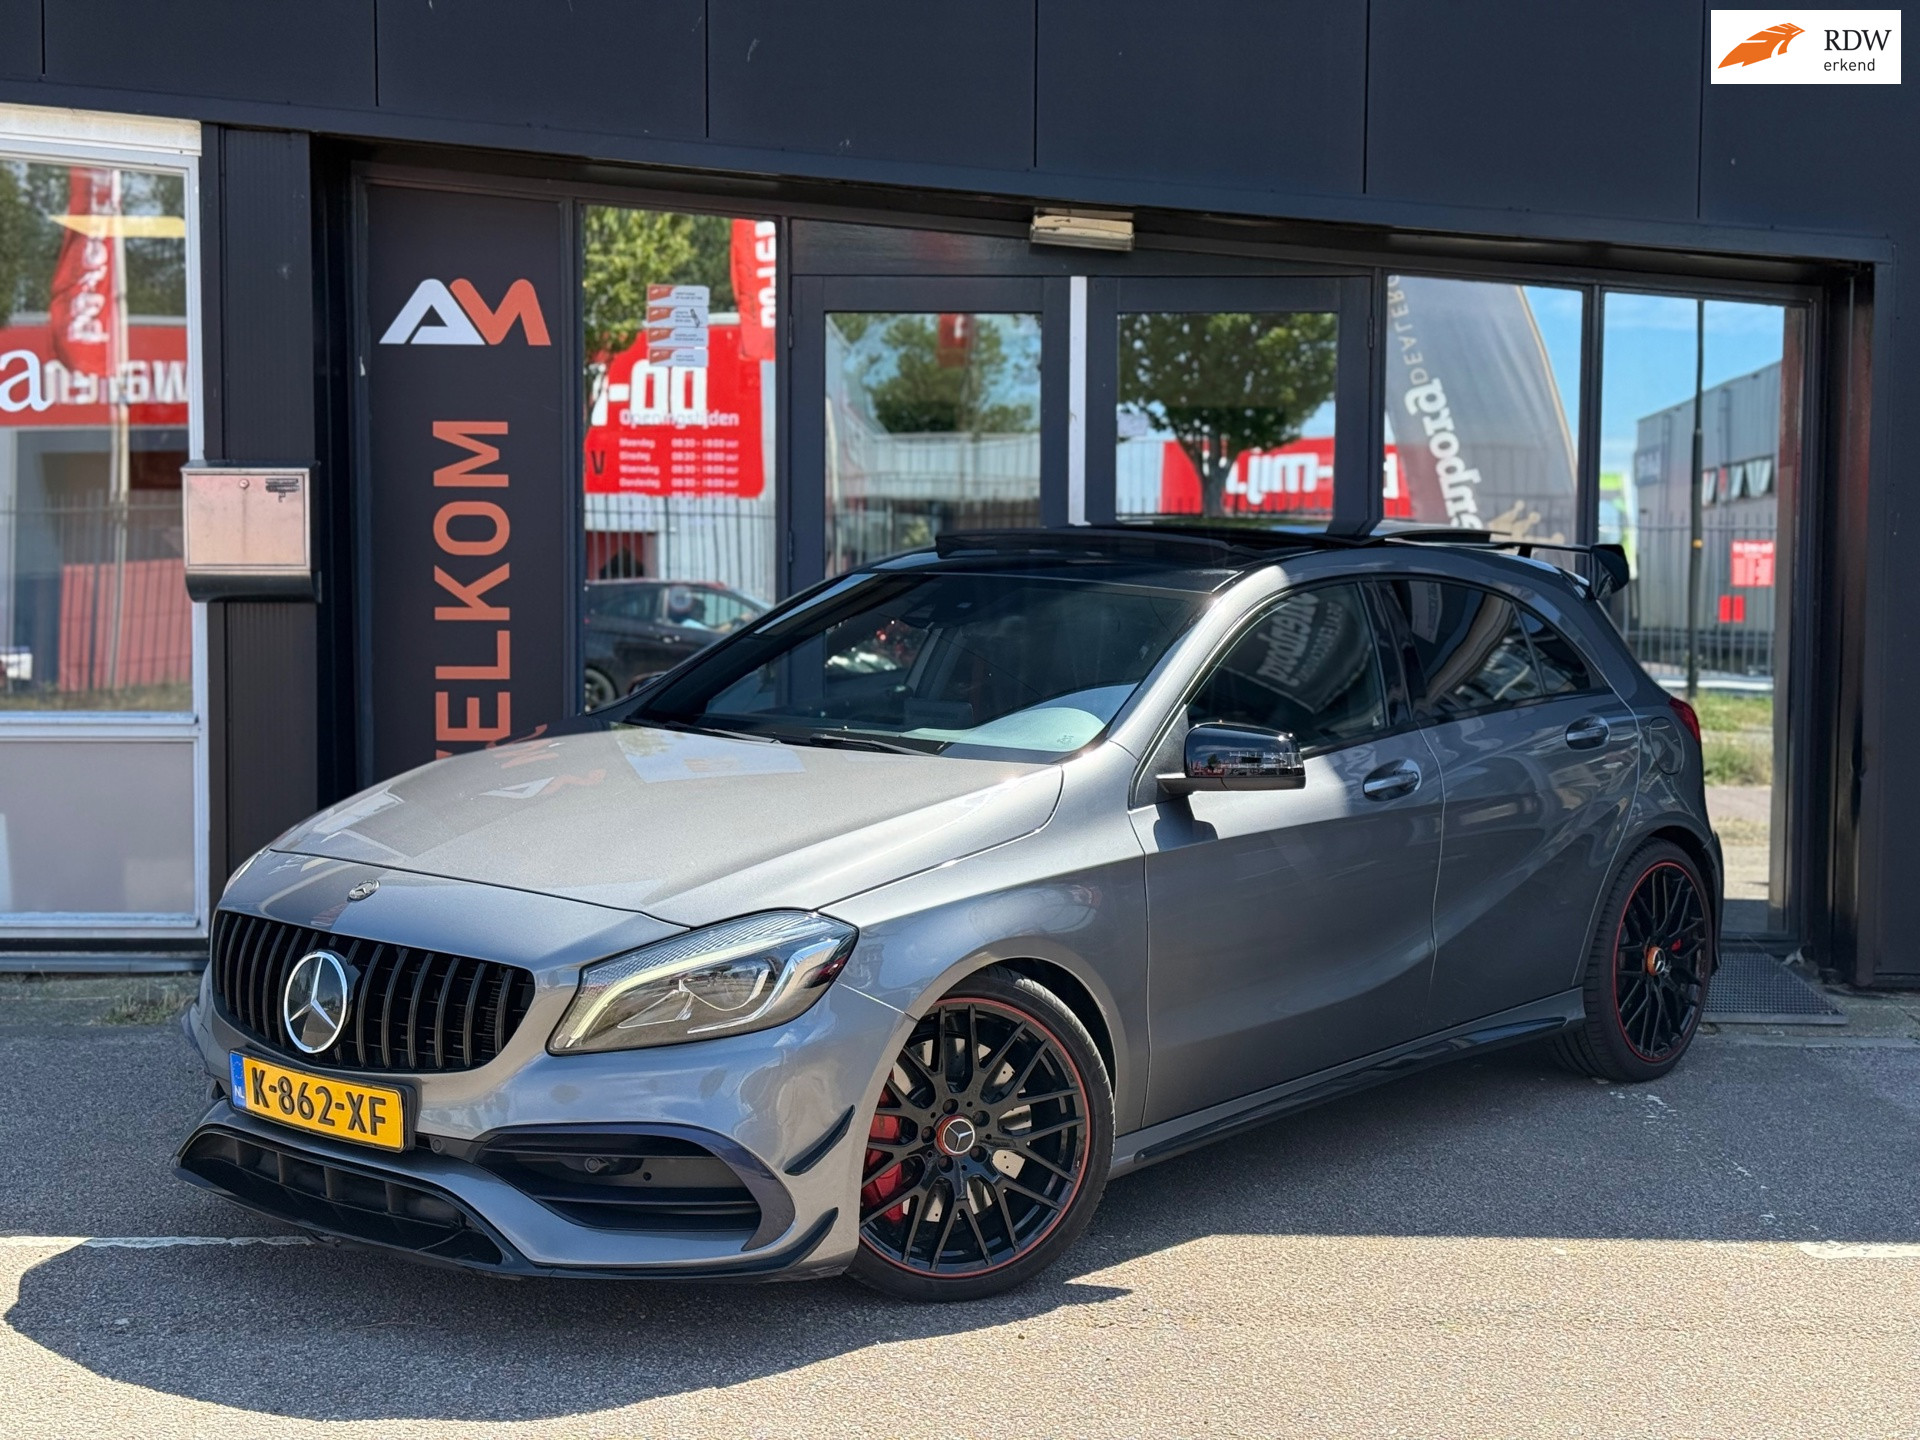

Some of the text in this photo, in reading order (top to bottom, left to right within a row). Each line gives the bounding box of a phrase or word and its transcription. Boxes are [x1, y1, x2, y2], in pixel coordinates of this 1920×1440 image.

[432, 421, 511, 759] ELKOM
[234, 1084, 245, 1099] NL
[251, 1066, 387, 1136] K-862-XF
